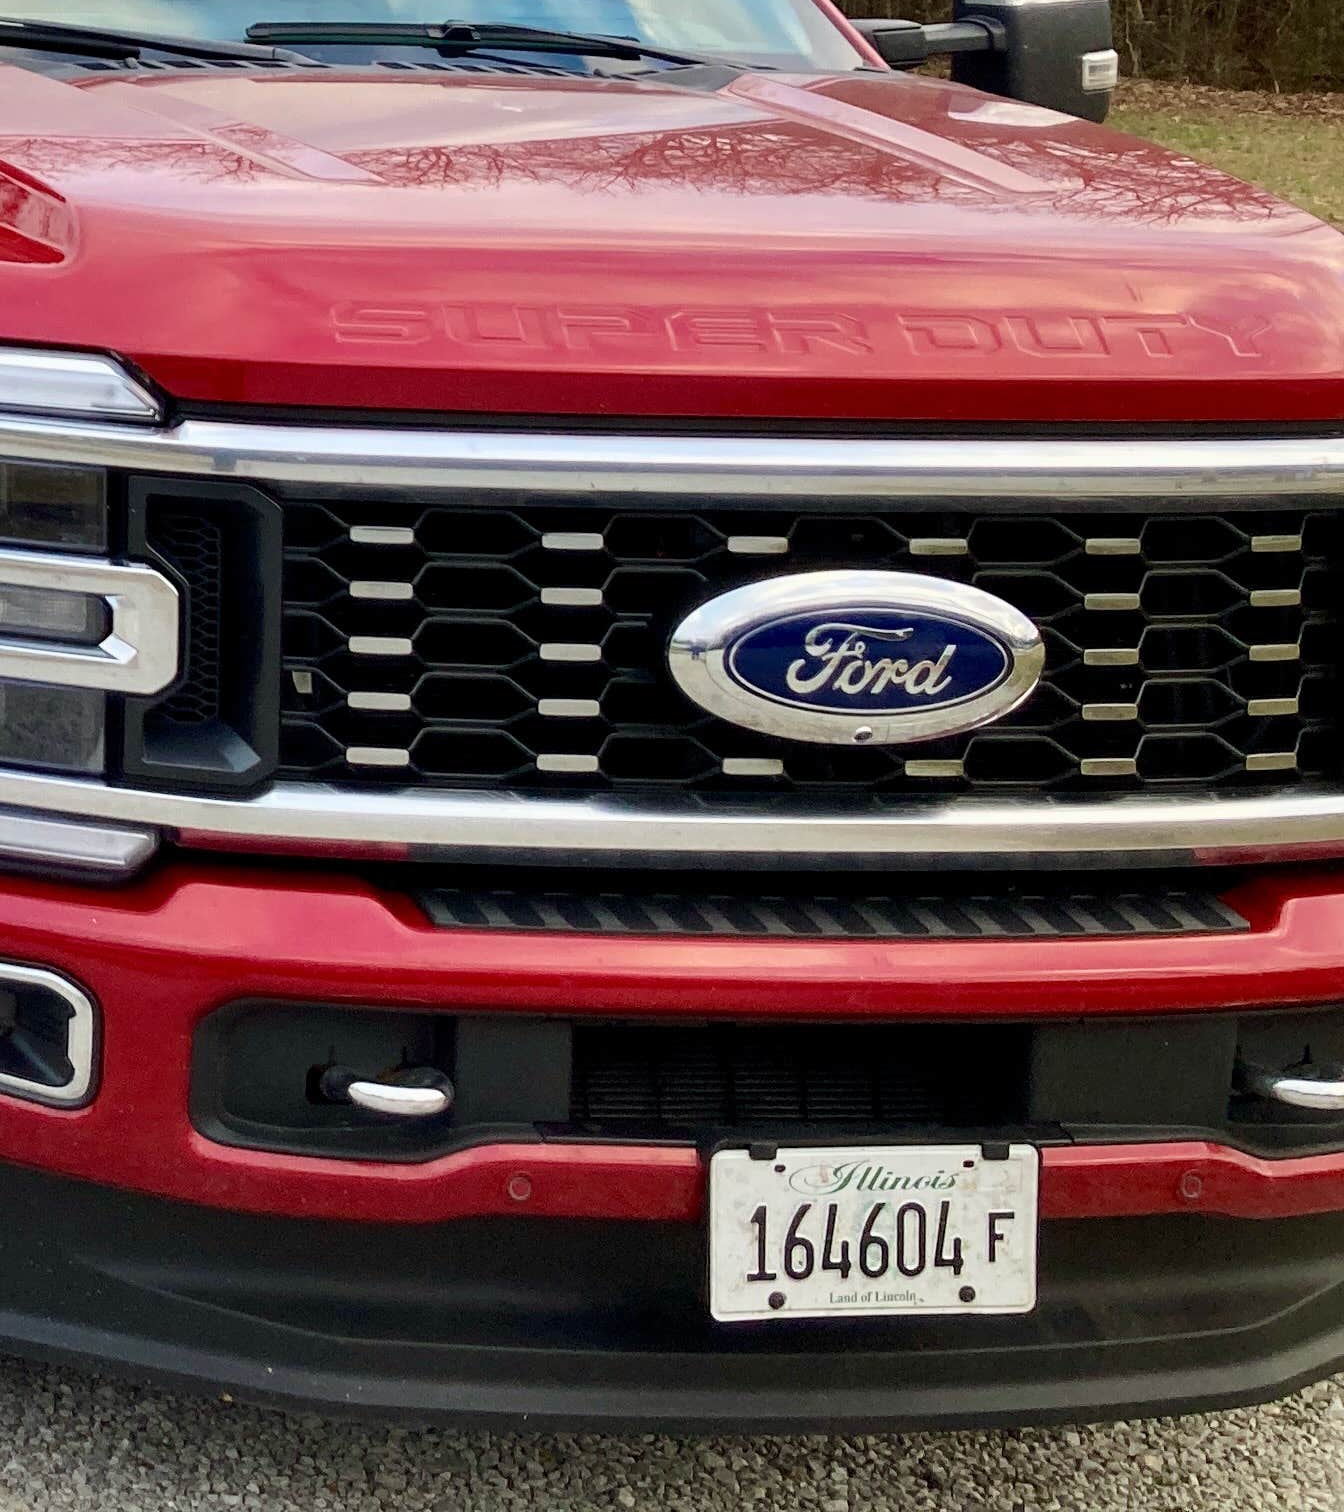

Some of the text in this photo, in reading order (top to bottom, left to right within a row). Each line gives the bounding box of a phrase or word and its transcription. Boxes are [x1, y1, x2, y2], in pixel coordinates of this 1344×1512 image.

[330, 301, 1273, 359] SUPER DUTY
[786, 622, 956, 695] Ford
[789, 1159, 959, 1195] Illinois
[747, 1200, 1015, 1282] 164604 F
[829, 1290, 917, 1304] Land of Lincoln
